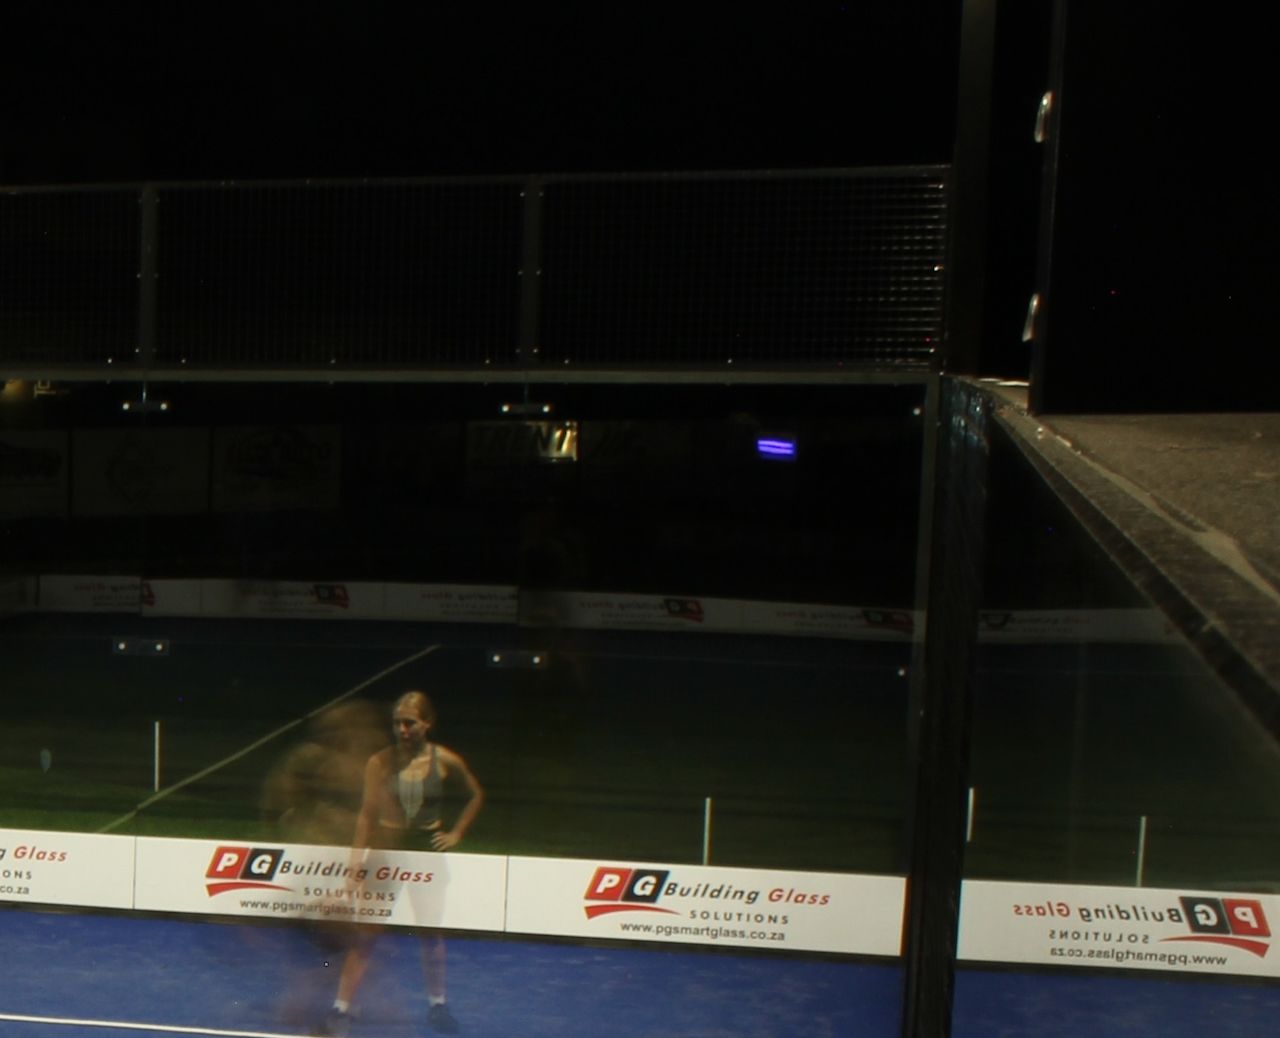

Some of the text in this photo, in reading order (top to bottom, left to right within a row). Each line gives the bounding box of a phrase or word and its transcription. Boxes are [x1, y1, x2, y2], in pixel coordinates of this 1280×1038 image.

[13, 845, 68, 863] Glass
[279, 859, 368, 882] Building
[375, 866, 435, 884] Glass
[303, 886, 396, 902] SOLUTIONS
[593, 871, 832, 906] PG Building Glass
[240, 898, 393, 918] www.pgsmartglass.co.za
[689, 909, 790, 926] SOLUTIONS
[620, 920, 786, 941] www.pgsmartglass.co.za
